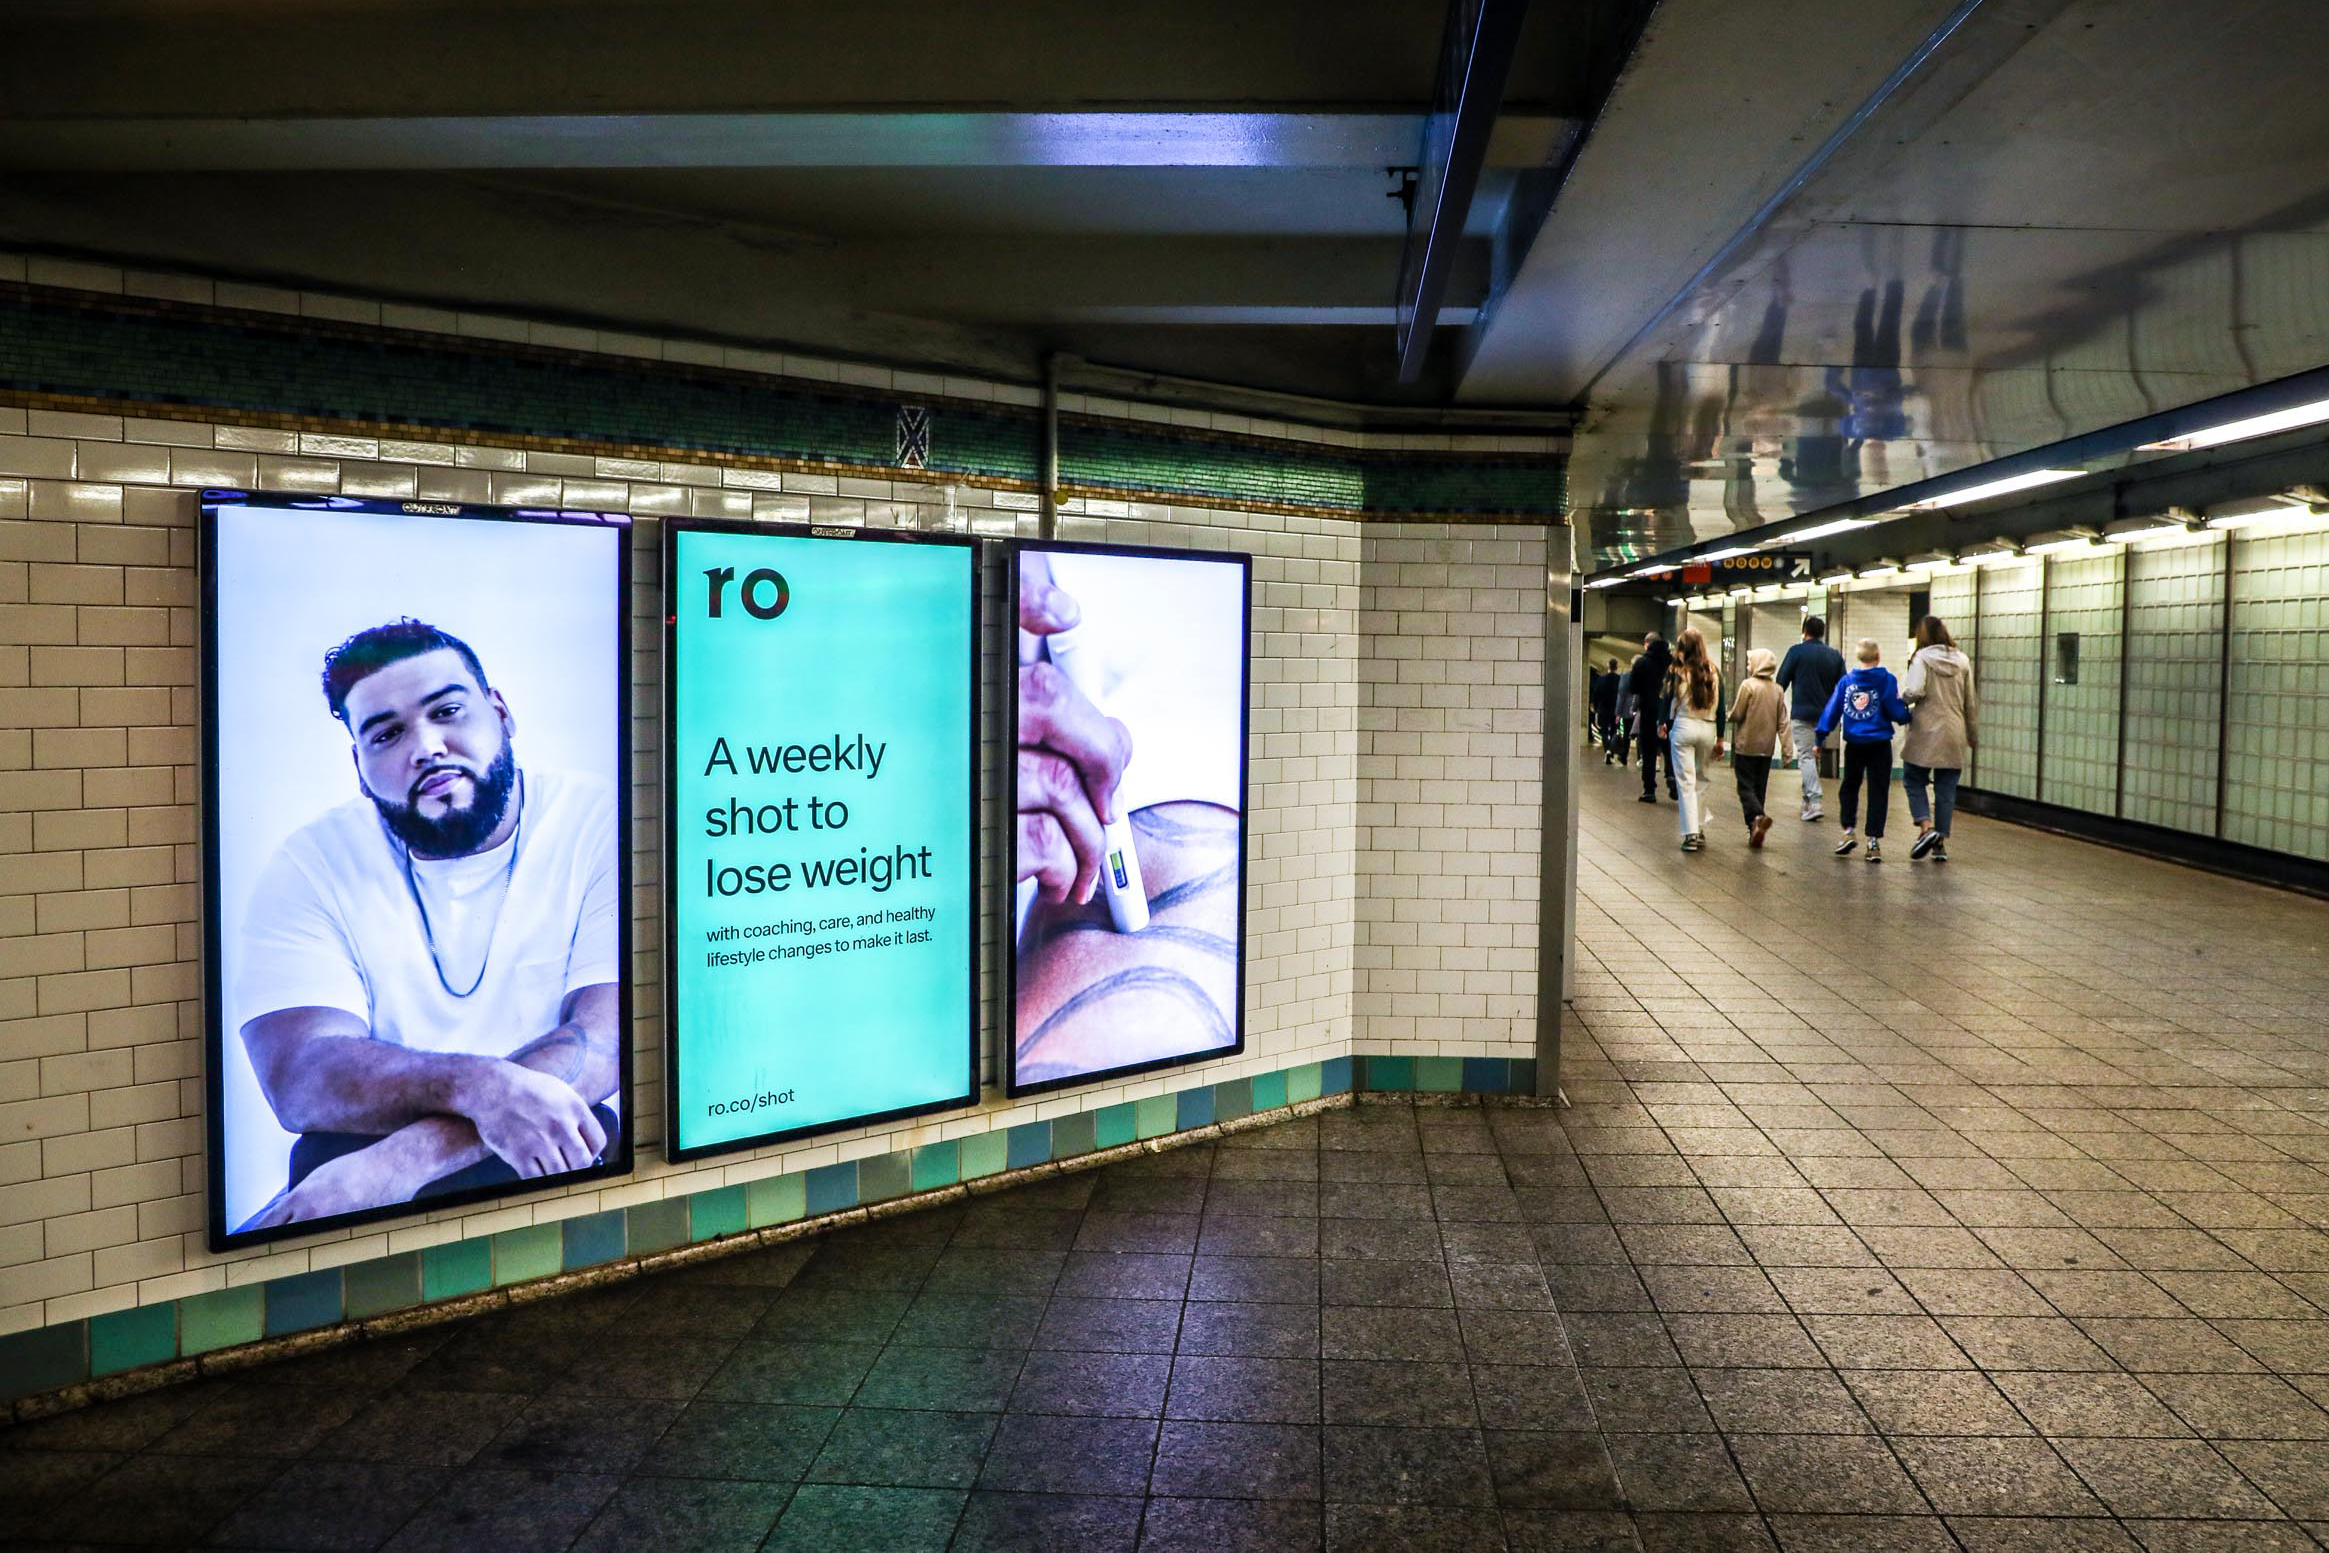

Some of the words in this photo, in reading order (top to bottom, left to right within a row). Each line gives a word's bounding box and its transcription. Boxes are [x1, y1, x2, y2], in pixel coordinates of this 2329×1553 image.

[703, 566, 790, 620] ro
[704, 737, 738, 776] A
[747, 733, 887, 779] weekly
[706, 797, 799, 837] shot
[807, 796, 849, 830] to
[706, 858, 792, 897] lose
[801, 845, 933, 893] weight
[706, 925, 740, 942] with
[743, 919, 816, 938] coaching,
[819, 916, 854, 930] care,
[856, 910, 883, 926] and
[886, 905, 936, 923] healthy
[707, 948, 765, 967] lifestyle
[768, 943, 832, 960] changes
[835, 940, 850, 952] to
[852, 933, 892, 950] make
[894, 931, 904, 945] it
[905, 929, 933, 944] last.
[708, 1088, 795, 1116] ro.co/shot
